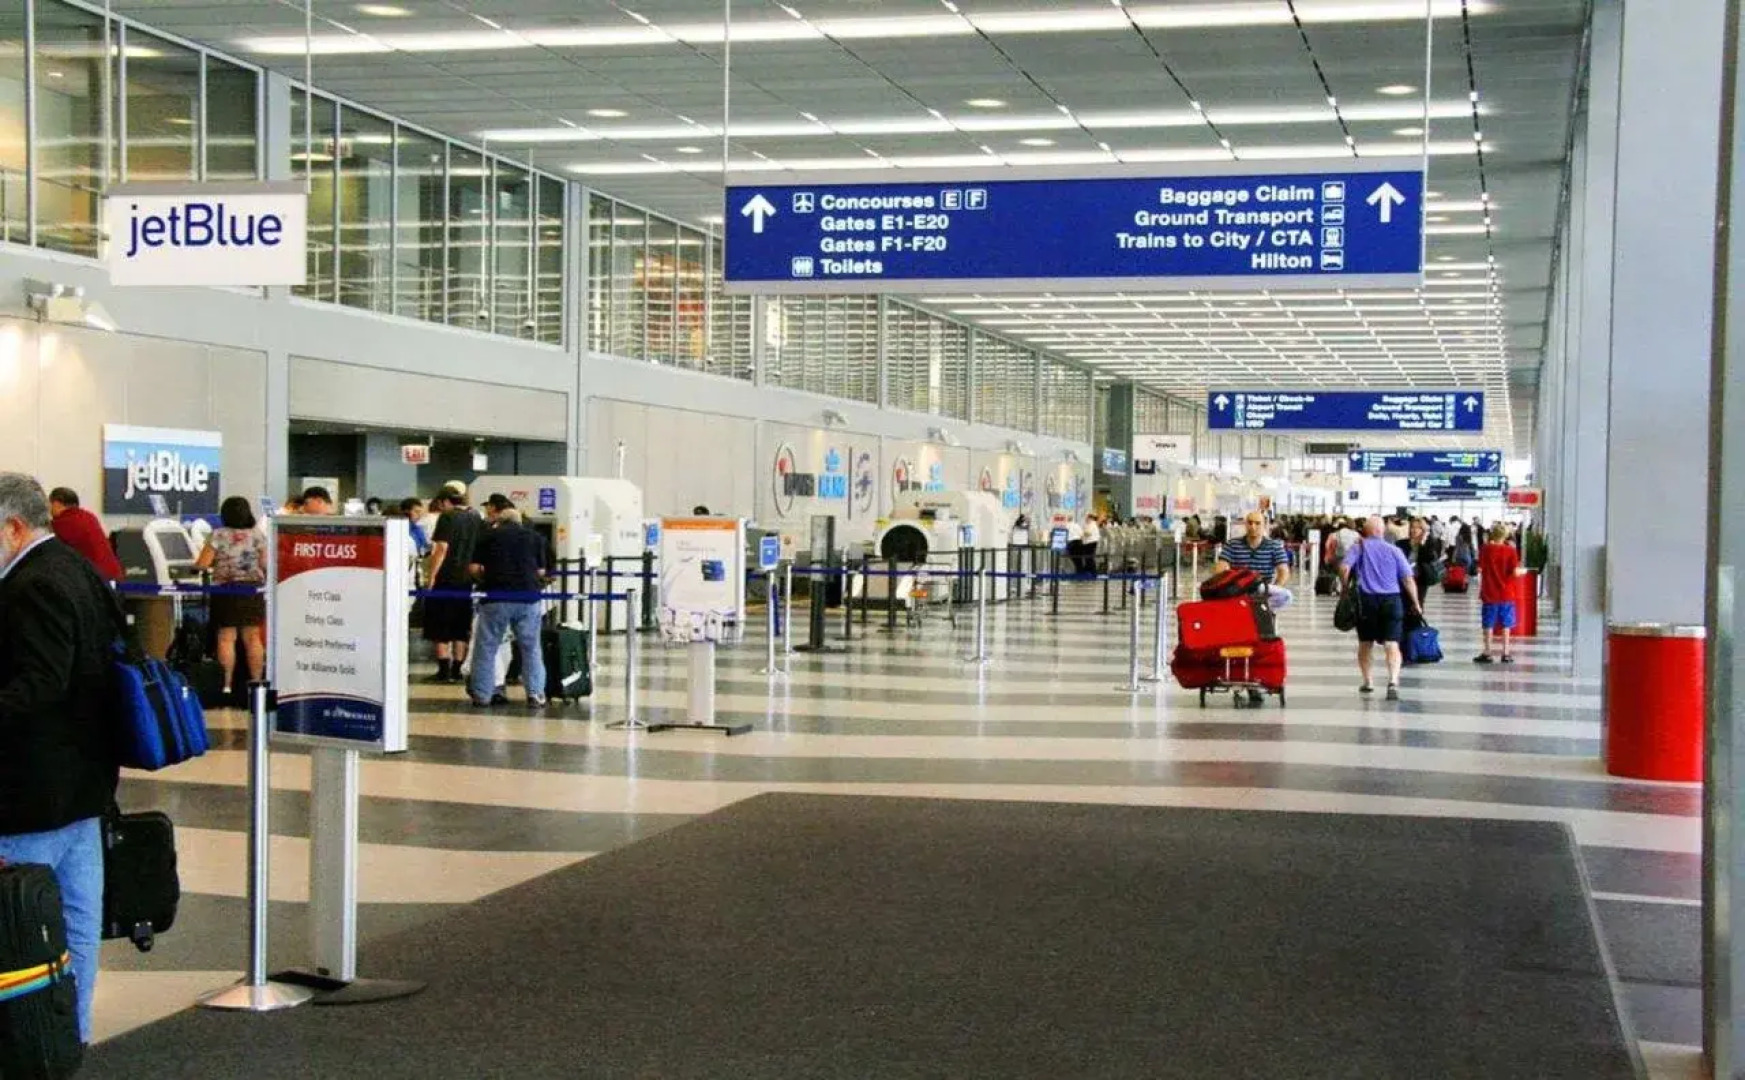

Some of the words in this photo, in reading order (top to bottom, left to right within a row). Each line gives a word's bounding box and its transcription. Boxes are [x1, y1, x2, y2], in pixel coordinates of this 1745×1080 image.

[820, 194, 935, 210] Concourses
[944, 192, 958, 207] E
[970, 191, 982, 207] F
[1159, 187, 1249, 206] Baggage
[1255, 185, 1315, 202] Claim
[820, 216, 876, 231] Gates
[881, 214, 950, 230] E1-E20
[1134, 209, 1209, 226] Ground
[1214, 208, 1314, 226] Transport
[126, 203, 283, 257] jetBlue
[820, 237, 876, 252] Gates
[881, 235, 947, 251] F1-F20
[1115, 232, 1177, 249] Trains
[1183, 232, 1204, 248] to
[1209, 231, 1251, 250] City
[1255, 230, 1264, 246] /
[1271, 229, 1313, 247] CTA
[820, 258, 883, 274] Toilets
[1251, 253, 1313, 269] Hilton
[124, 447, 208, 500] jetBlue
[293, 542, 323, 557] FIRST
[323, 543, 357, 559] CLASS
[307, 589, 323, 601] First
[323, 591, 342, 602] Class
